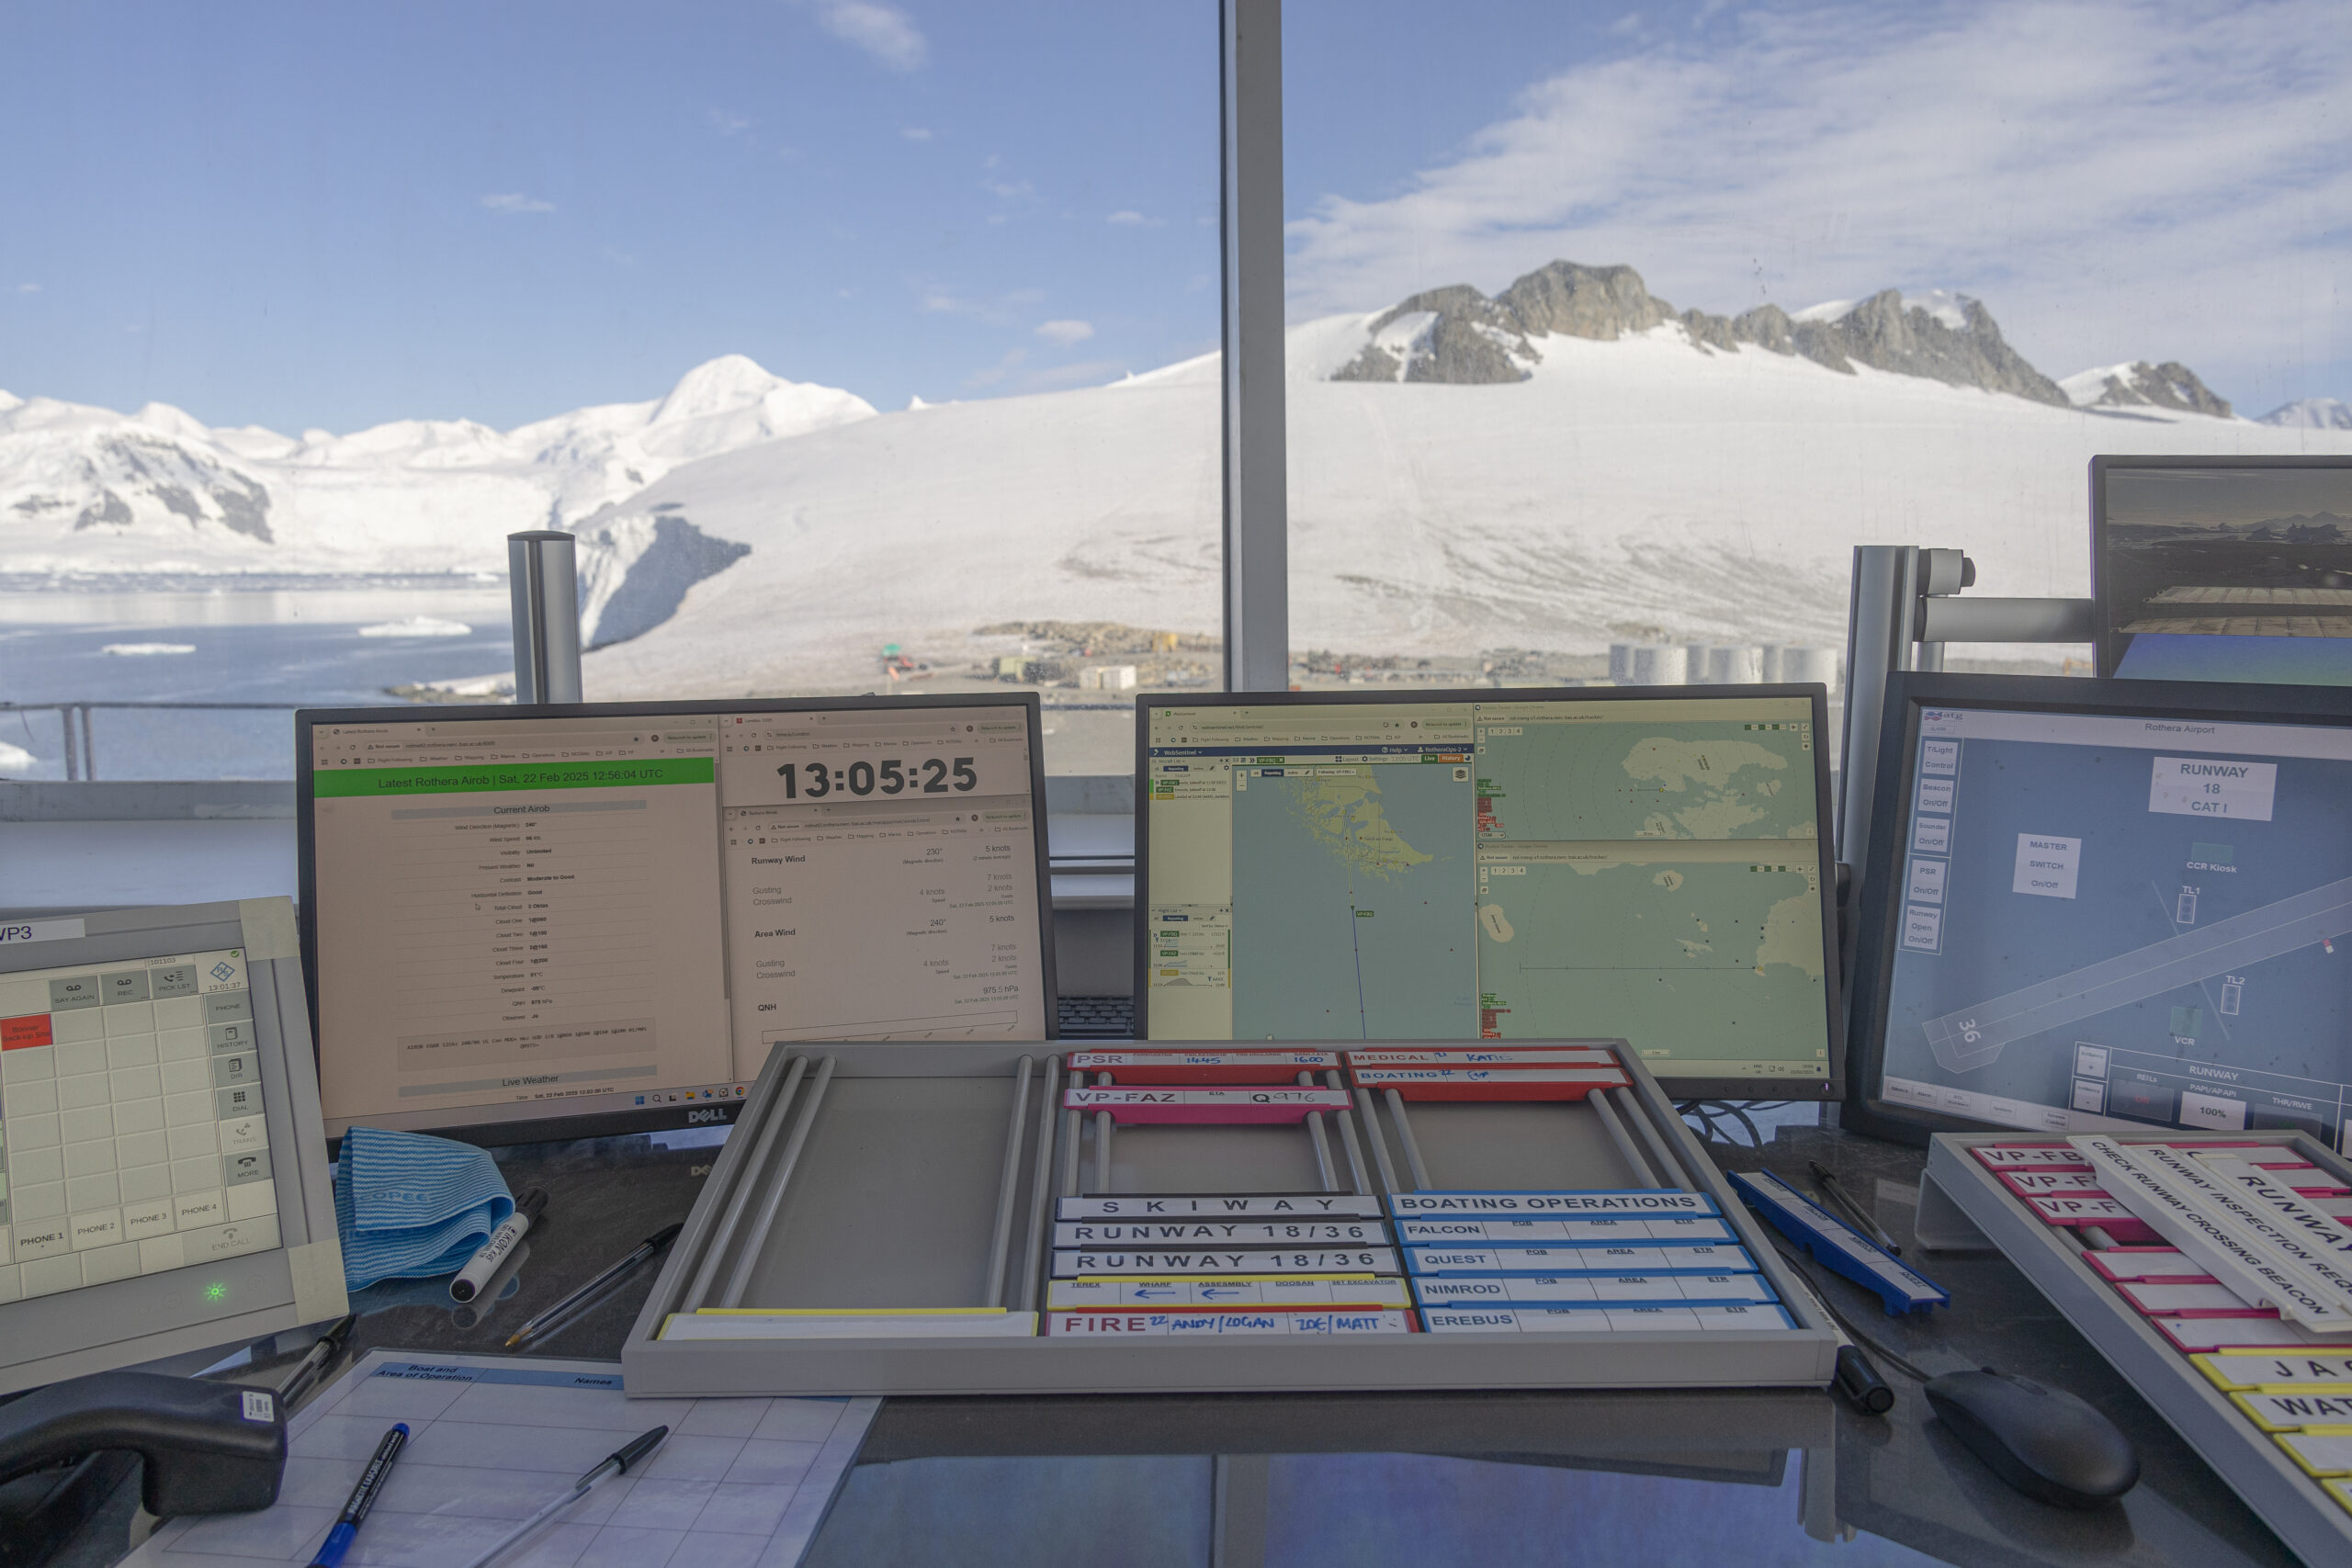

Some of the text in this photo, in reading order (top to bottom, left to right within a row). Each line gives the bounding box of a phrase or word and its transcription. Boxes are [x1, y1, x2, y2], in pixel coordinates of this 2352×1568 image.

[1943, 712, 1963, 720] atg
[2145, 723, 2215, 734] Rothera Airport
[1927, 746, 1953, 754] T/Light
[1925, 761, 1953, 770] Control
[2180, 763, 2249, 778] RUNWAY
[378, 769, 663, 788] Latest Rothera Airob Sat, 22 Feb 2025 12:56:04 UTC
[776, 757, 978, 799] 13:05:25
[2203, 784, 2221, 795] 18
[493, 805, 550, 814] Current Airob
[2191, 801, 2228, 813] CAT I
[1918, 838, 1944, 846] On/Off
[2030, 840, 2067, 852] MASTER
[2030, 860, 2064, 870] SWITCH
[2187, 862, 2237, 873] CCR Kiosk
[2030, 880, 2059, 889] On/Off
[752, 886, 781, 895] Gusting
[1914, 886, 1939, 896] On/Off
[2183, 886, 2200, 895] TL1
[753, 897, 792, 906] Crosswind
[1909, 909, 1938, 919] Runway
[1911, 923, 1932, 931] Open
[1908, 935, 1934, 945] On/Off
[757, 970, 796, 979] Crosswind
[2225, 976, 2245, 985] TL2
[209, 982, 241, 991] 13:01:37
[71, 994, 95, 1002] AGAIN
[758, 1003, 776, 1011] QNH
[1959, 1018, 1981, 1043] 36
[217, 1040, 249, 1049] HISTORY
[2175, 1036, 2196, 1046] VCR
[2136, 1073, 2157, 1083] REILs
[2189, 1065, 2239, 1081] RUNWAY
[503, 1076, 560, 1087] Live Weather
[2189, 1083, 2237, 1098] PAPI/APAPI
[1075, 1093, 1175, 1102] VP-FAZ
[2272, 1097, 2313, 1111] THR/RWE
[688, 1108, 727, 1122] DELL
[2199, 1106, 2227, 1119] 100%
[232, 1136, 257, 1145] TRANS
[238, 1169, 259, 1179] MORE
[2014, 1176, 2097, 1188] VP-F
[1102, 1199, 1334, 1213] SKIWAY
[1400, 1197, 1696, 1209] BOATING OPERATIONS
[181, 1205, 210, 1216] PHONE
[130, 1215, 159, 1225] PHONE
[2148, 1149, 2352, 1295] RUNWAY INSPECTION REQ
[77, 1224, 107, 1235] PHONE
[1075, 1224, 1363, 1239] RUNWAY 18/36
[1408, 1225, 1480, 1234] FALCON
[2091, 1141, 2329, 1315] CHECK RUNWAY CROSSING BEACON
[20, 1234, 55, 1247] PHONE
[212, 1238, 251, 1251] END CALL
[1848, 1236, 1877, 1253] NIMROD
[1077, 1253, 1374, 1269] RUNWAY 18/36
[1424, 1255, 1487, 1264] QUEST
[1899, 1270, 1928, 1288] QUEST
[1425, 1285, 1501, 1294] NIMROD
[1065, 1317, 1146, 1331] FIRE
[1149, 1315, 1168, 1326] 22
[1431, 1314, 1513, 1325] EREBUS
[420, 1372, 472, 1382] Operation
[574, 1378, 612, 1386] Names
